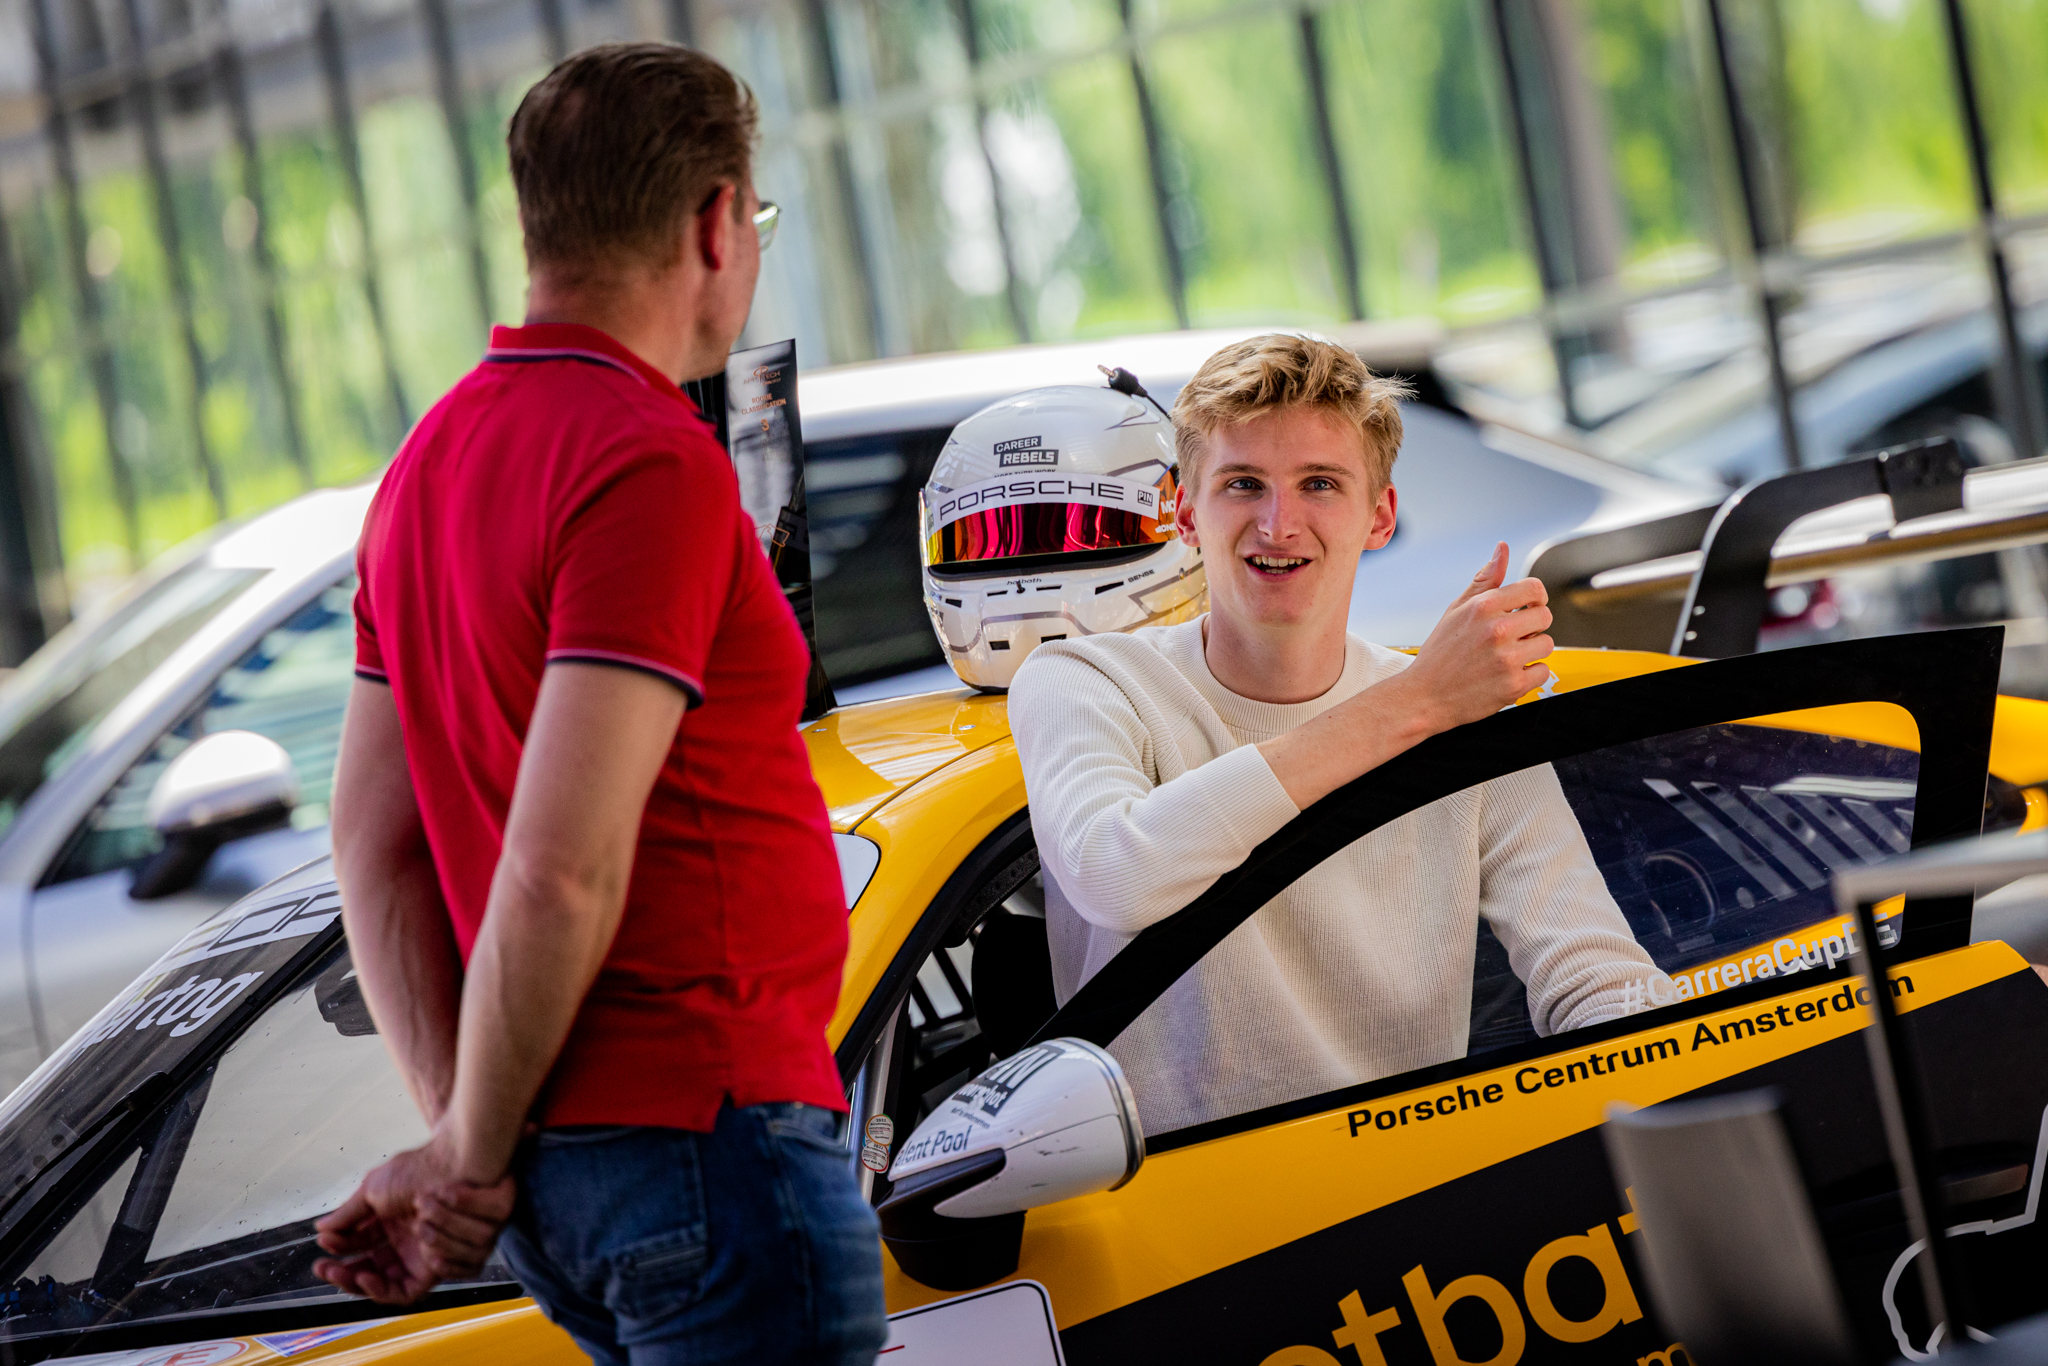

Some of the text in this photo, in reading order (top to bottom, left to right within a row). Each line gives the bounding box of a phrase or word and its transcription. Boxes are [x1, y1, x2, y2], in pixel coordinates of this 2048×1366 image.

[761, 418, 769, 431] 3
[996, 437, 1039, 453] CAREER
[1003, 451, 1055, 465] REBELS
[940, 480, 1124, 521] PORSCHE
[1138, 491, 1153, 503] PIN
[1348, 1083, 1503, 1137] Porsche
[1515, 1037, 1680, 1095] Centrum
[931, 1125, 972, 1156] Pool
